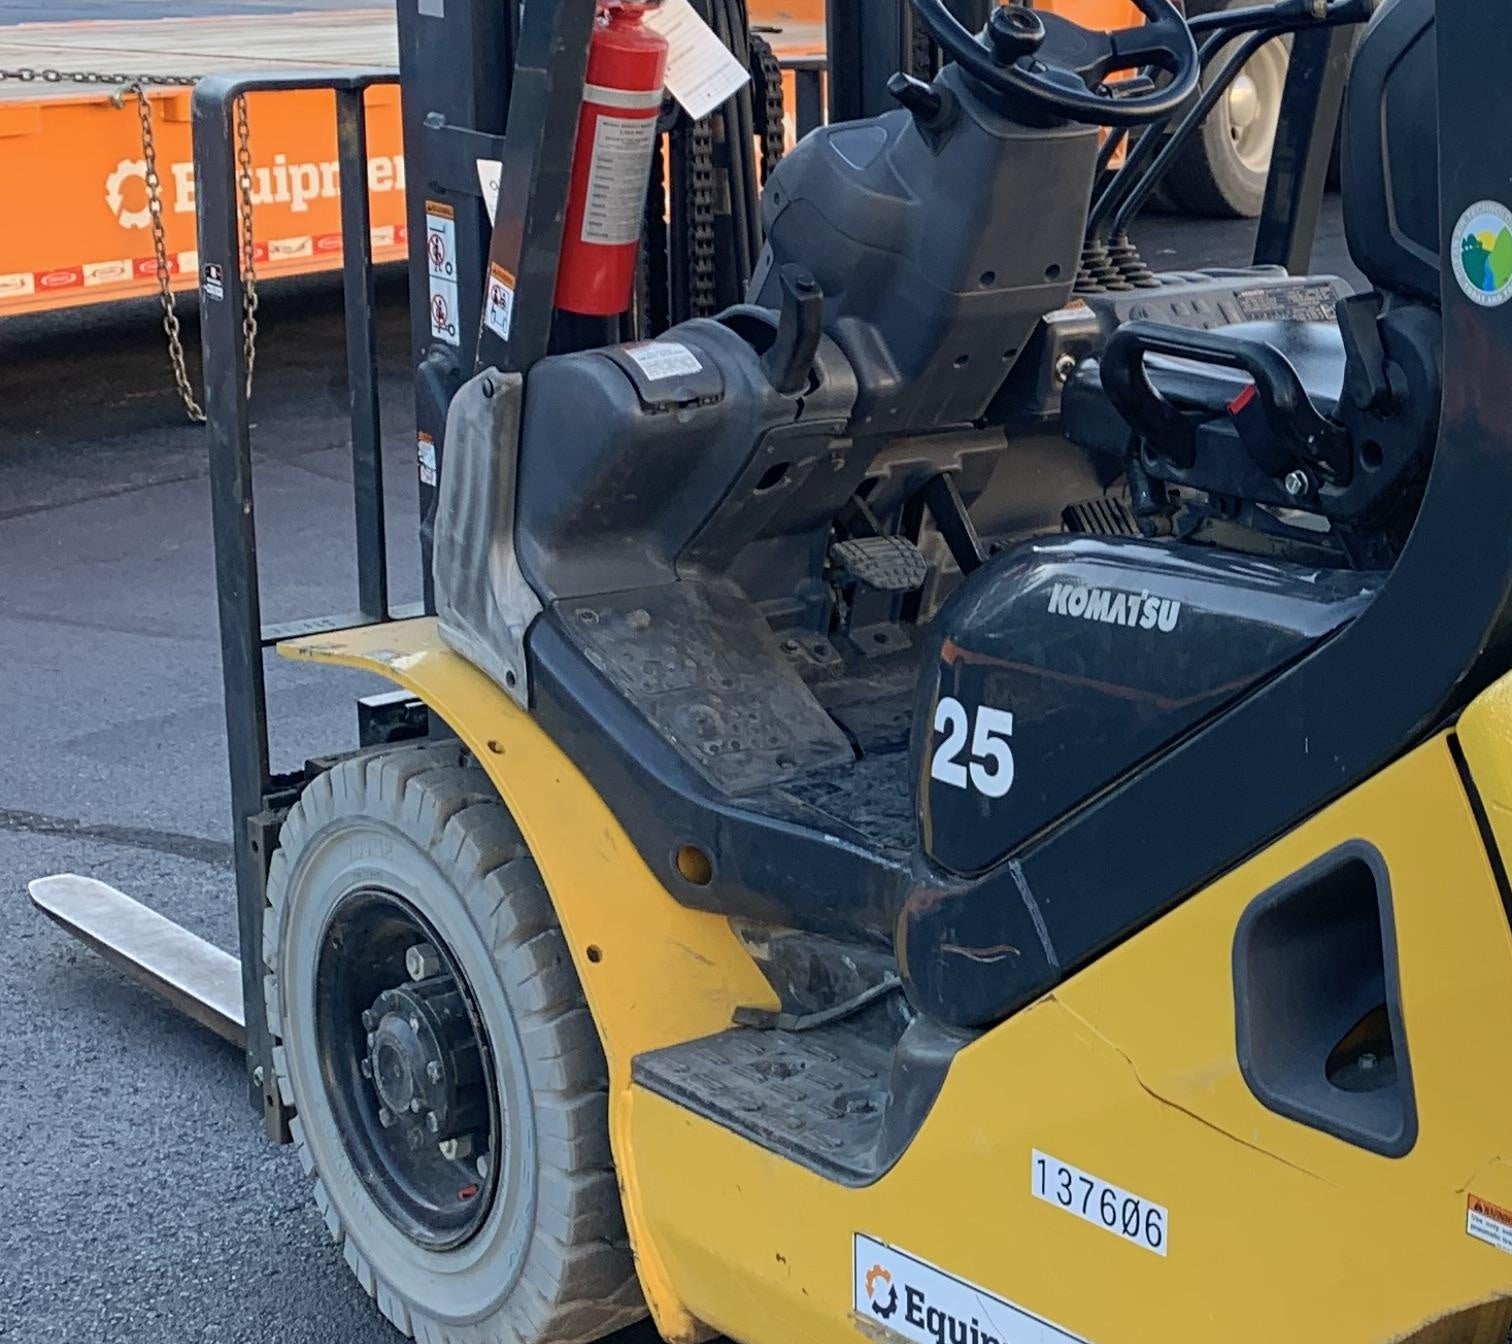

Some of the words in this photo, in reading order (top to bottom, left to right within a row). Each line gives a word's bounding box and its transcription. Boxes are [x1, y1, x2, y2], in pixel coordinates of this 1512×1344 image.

[1048, 582, 1181, 633] KOMATSU
[931, 696, 1015, 799] 25
[1037, 1158, 1162, 1248] 137606
